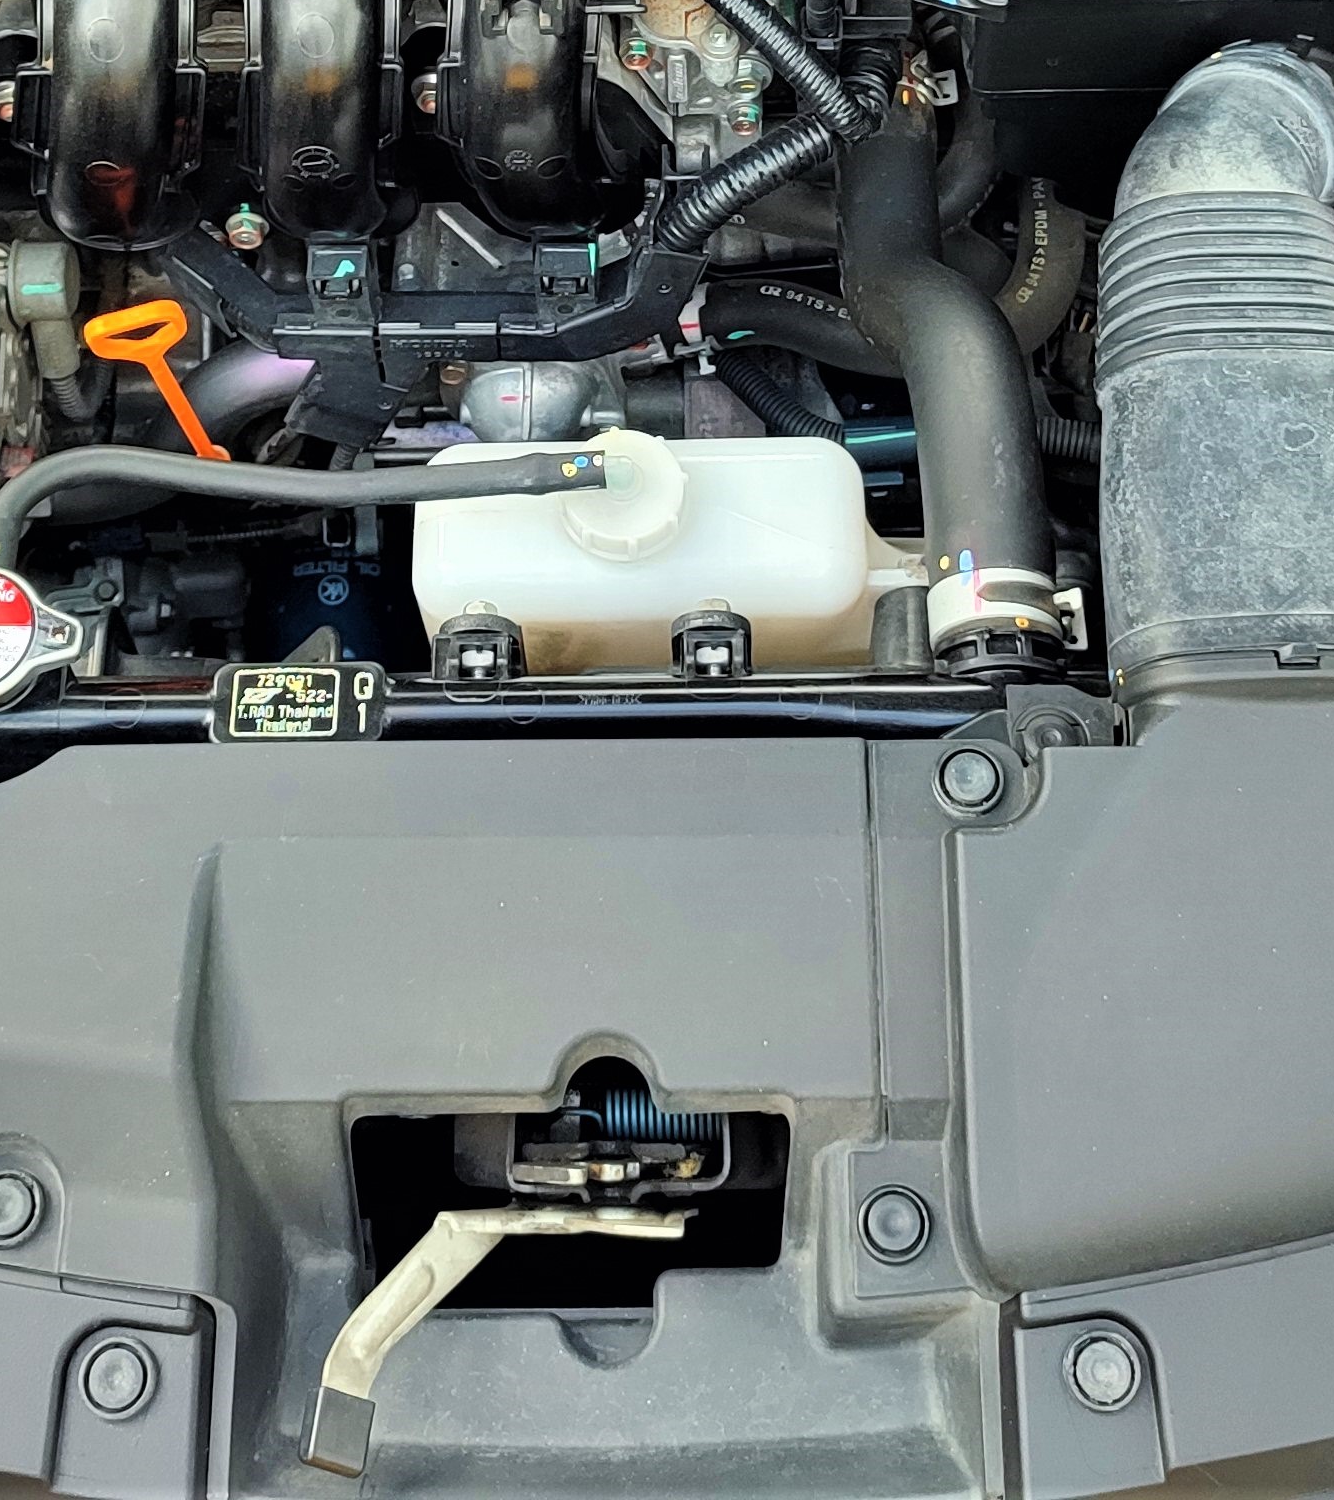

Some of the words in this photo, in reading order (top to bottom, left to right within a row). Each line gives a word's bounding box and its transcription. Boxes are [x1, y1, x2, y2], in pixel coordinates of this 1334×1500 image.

[292, 560, 348, 576] FILTER
[353, 561, 380, 576] OIL
[237, 704, 274, 719] T.RAD
[278, 704, 334, 718] Thailand
[356, 702, 367, 733] 1
